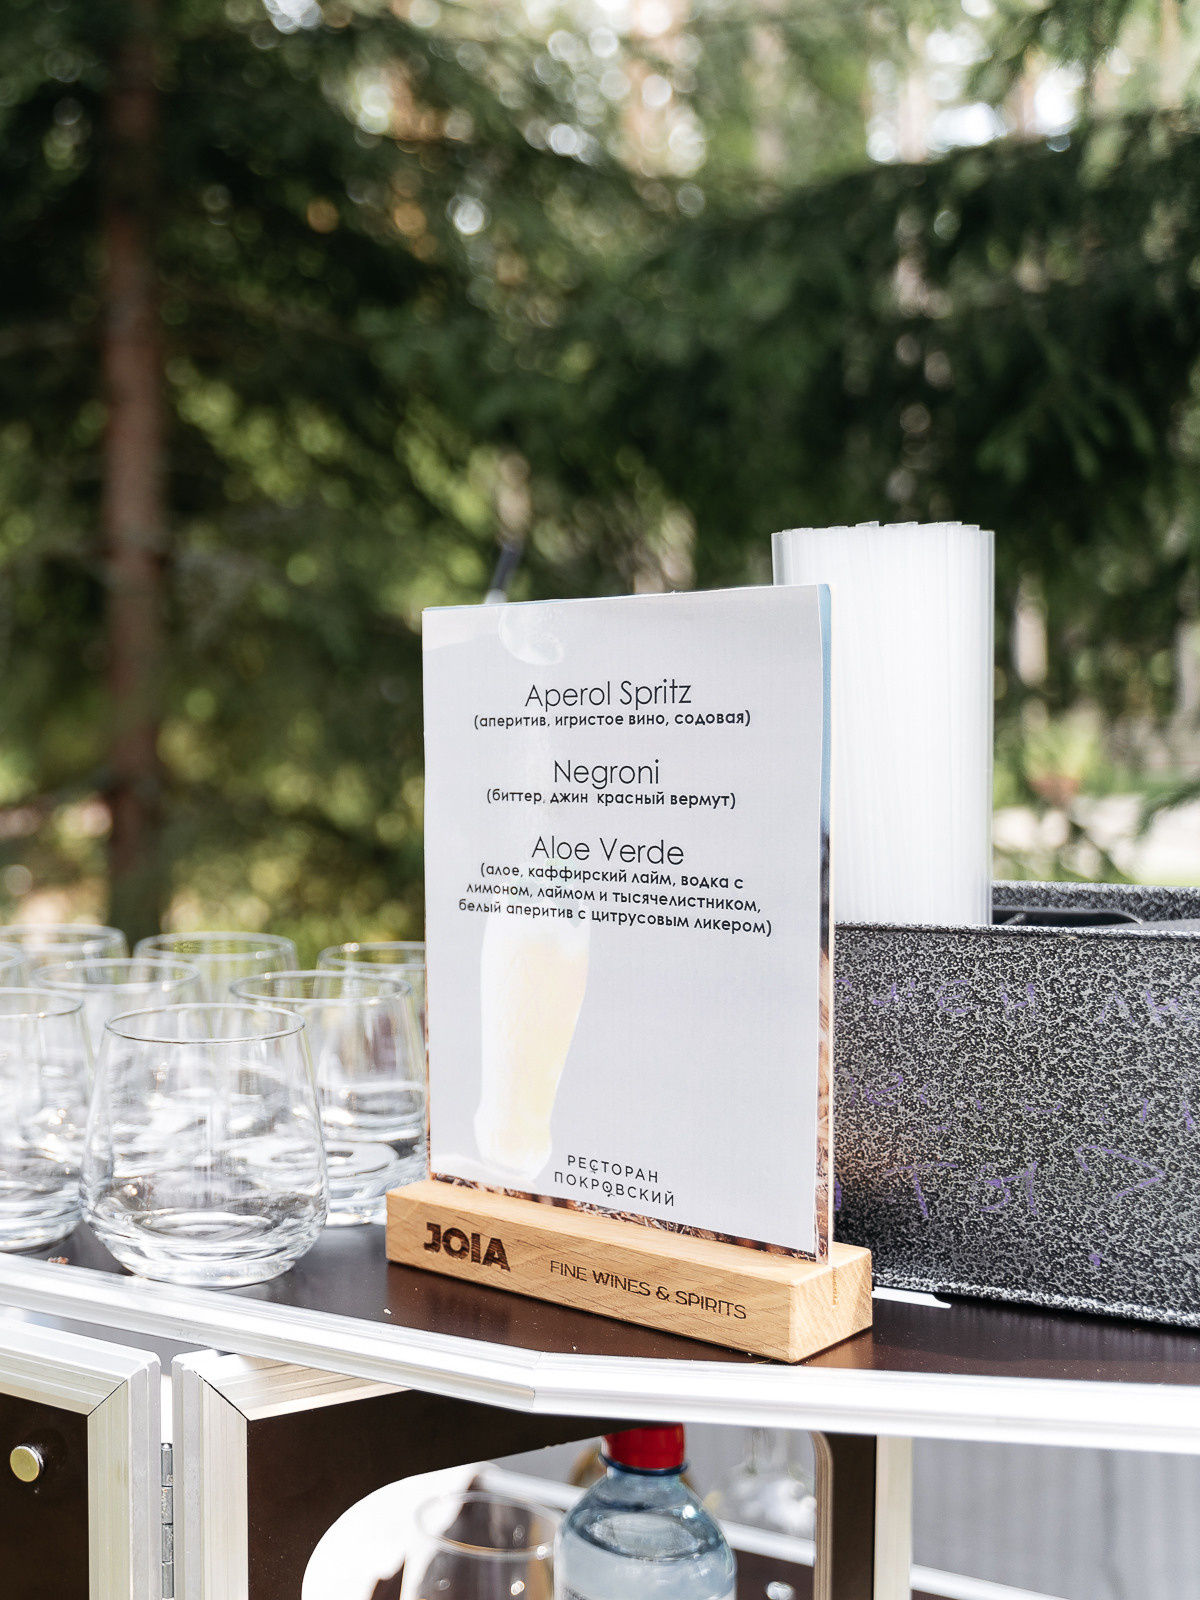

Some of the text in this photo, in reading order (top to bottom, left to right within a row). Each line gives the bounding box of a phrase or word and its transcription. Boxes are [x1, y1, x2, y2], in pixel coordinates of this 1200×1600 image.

[524, 678, 693, 712] Aperol Spritz
[473, 709, 751, 730] (аперитив, игристое вино, содовая)
[553, 758, 660, 790] Negroni
[550, 791, 588, 804] джин
[596, 789, 664, 807] красный
[670, 791, 736, 810] вермут)
[531, 834, 685, 866] Aloe Verde
[480, 862, 744, 890] (алое, каффирский лайм, водка с
[466, 882, 761, 914] лимоном, лаймом и тысячелистником,
[458, 898, 773, 938] белый аперитив с цитрусовым ликером)
[567, 1154, 658, 1183] РЕСТОРАН
[554, 1171, 675, 1207] ПОКРОВСКИЙ
[423, 1222, 511, 1272] JOIA
[550, 1260, 747, 1320] FINE WINES & SPIRITS
